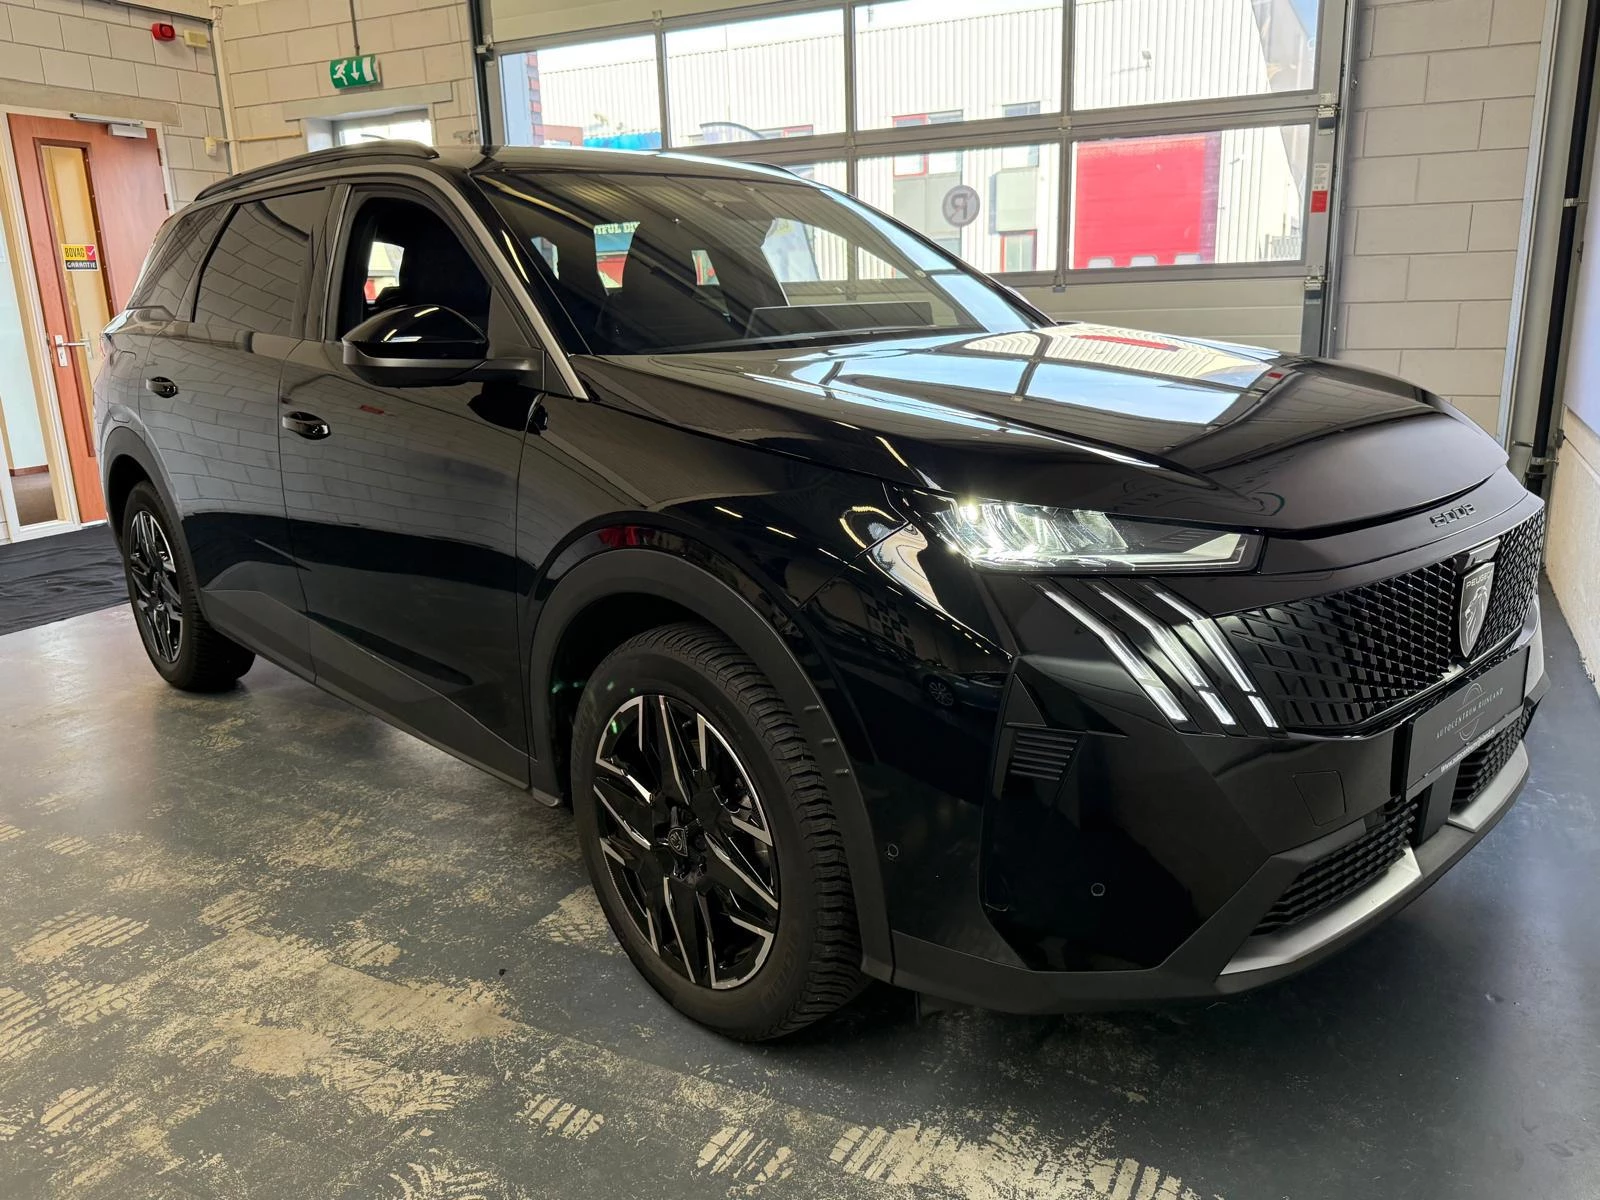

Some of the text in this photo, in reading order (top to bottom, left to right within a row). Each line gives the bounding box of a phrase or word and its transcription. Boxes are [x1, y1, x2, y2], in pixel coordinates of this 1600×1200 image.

[64, 247, 85, 258] BOVAG
[1430, 503, 1476, 527] 5008
[1436, 706, 1477, 739] AUTOCENTRUM
